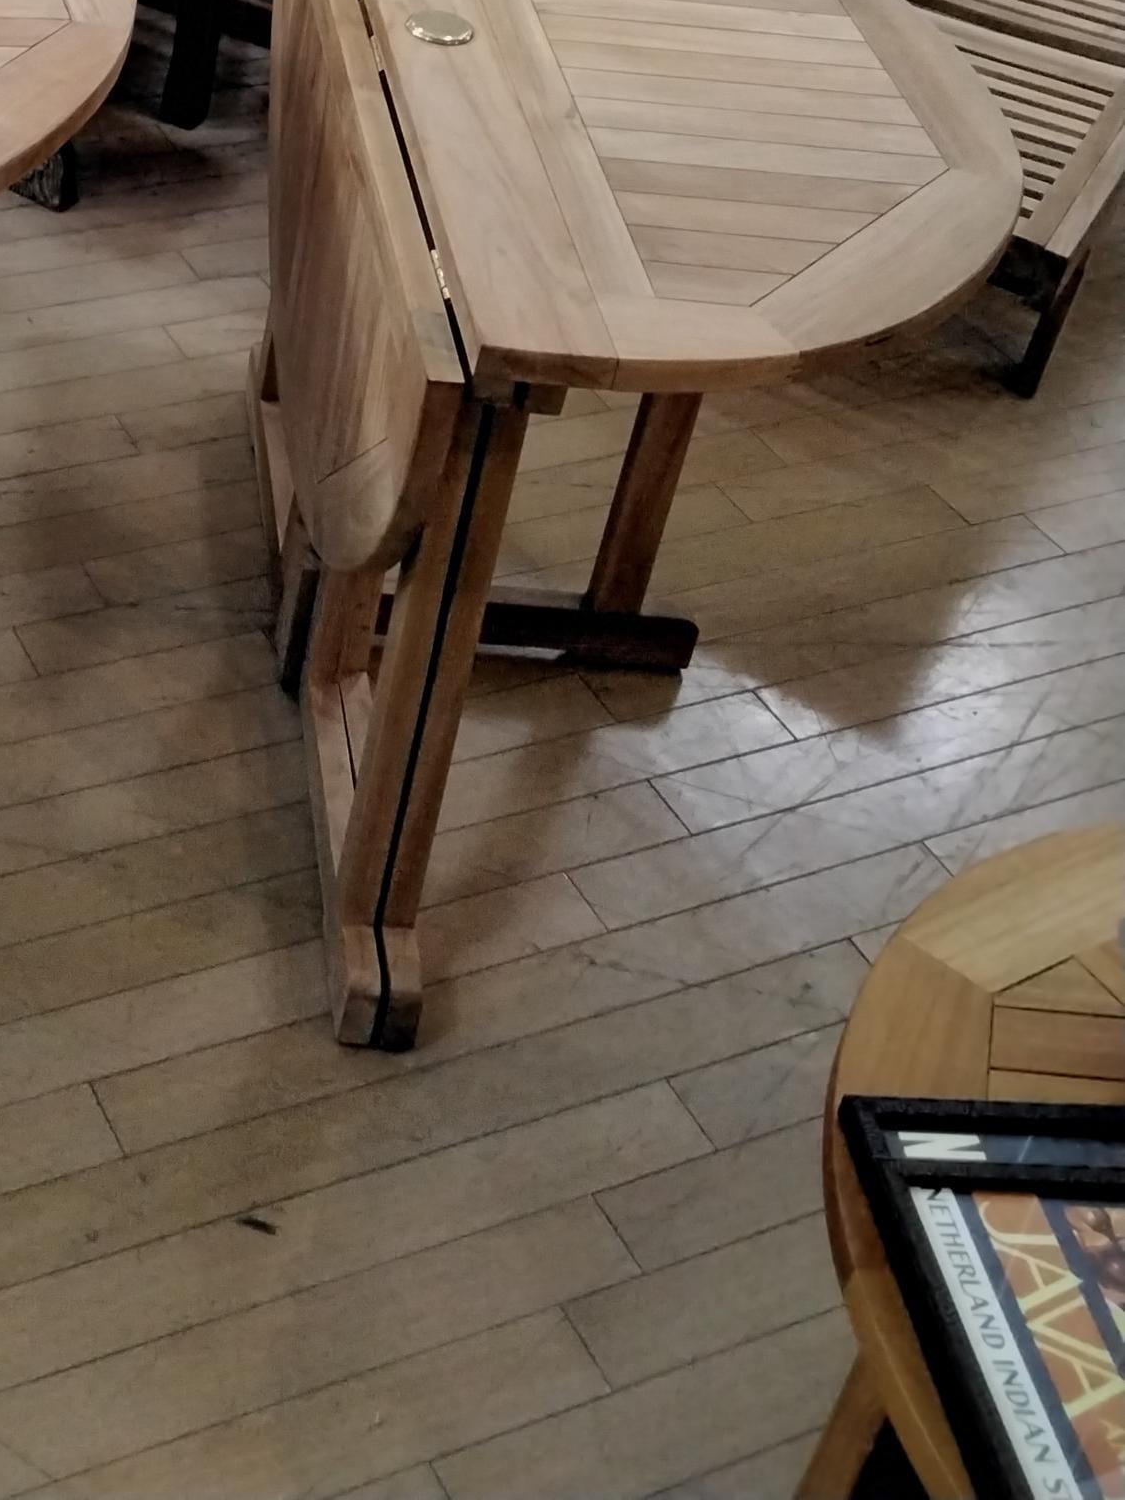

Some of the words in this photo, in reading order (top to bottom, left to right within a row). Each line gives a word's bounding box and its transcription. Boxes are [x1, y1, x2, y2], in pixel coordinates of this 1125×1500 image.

[927, 1187, 1006, 1350] NETHERLAND
[991, 1359, 1059, 1463] INDIAN
[977, 1201, 1125, 1419] JAVA
